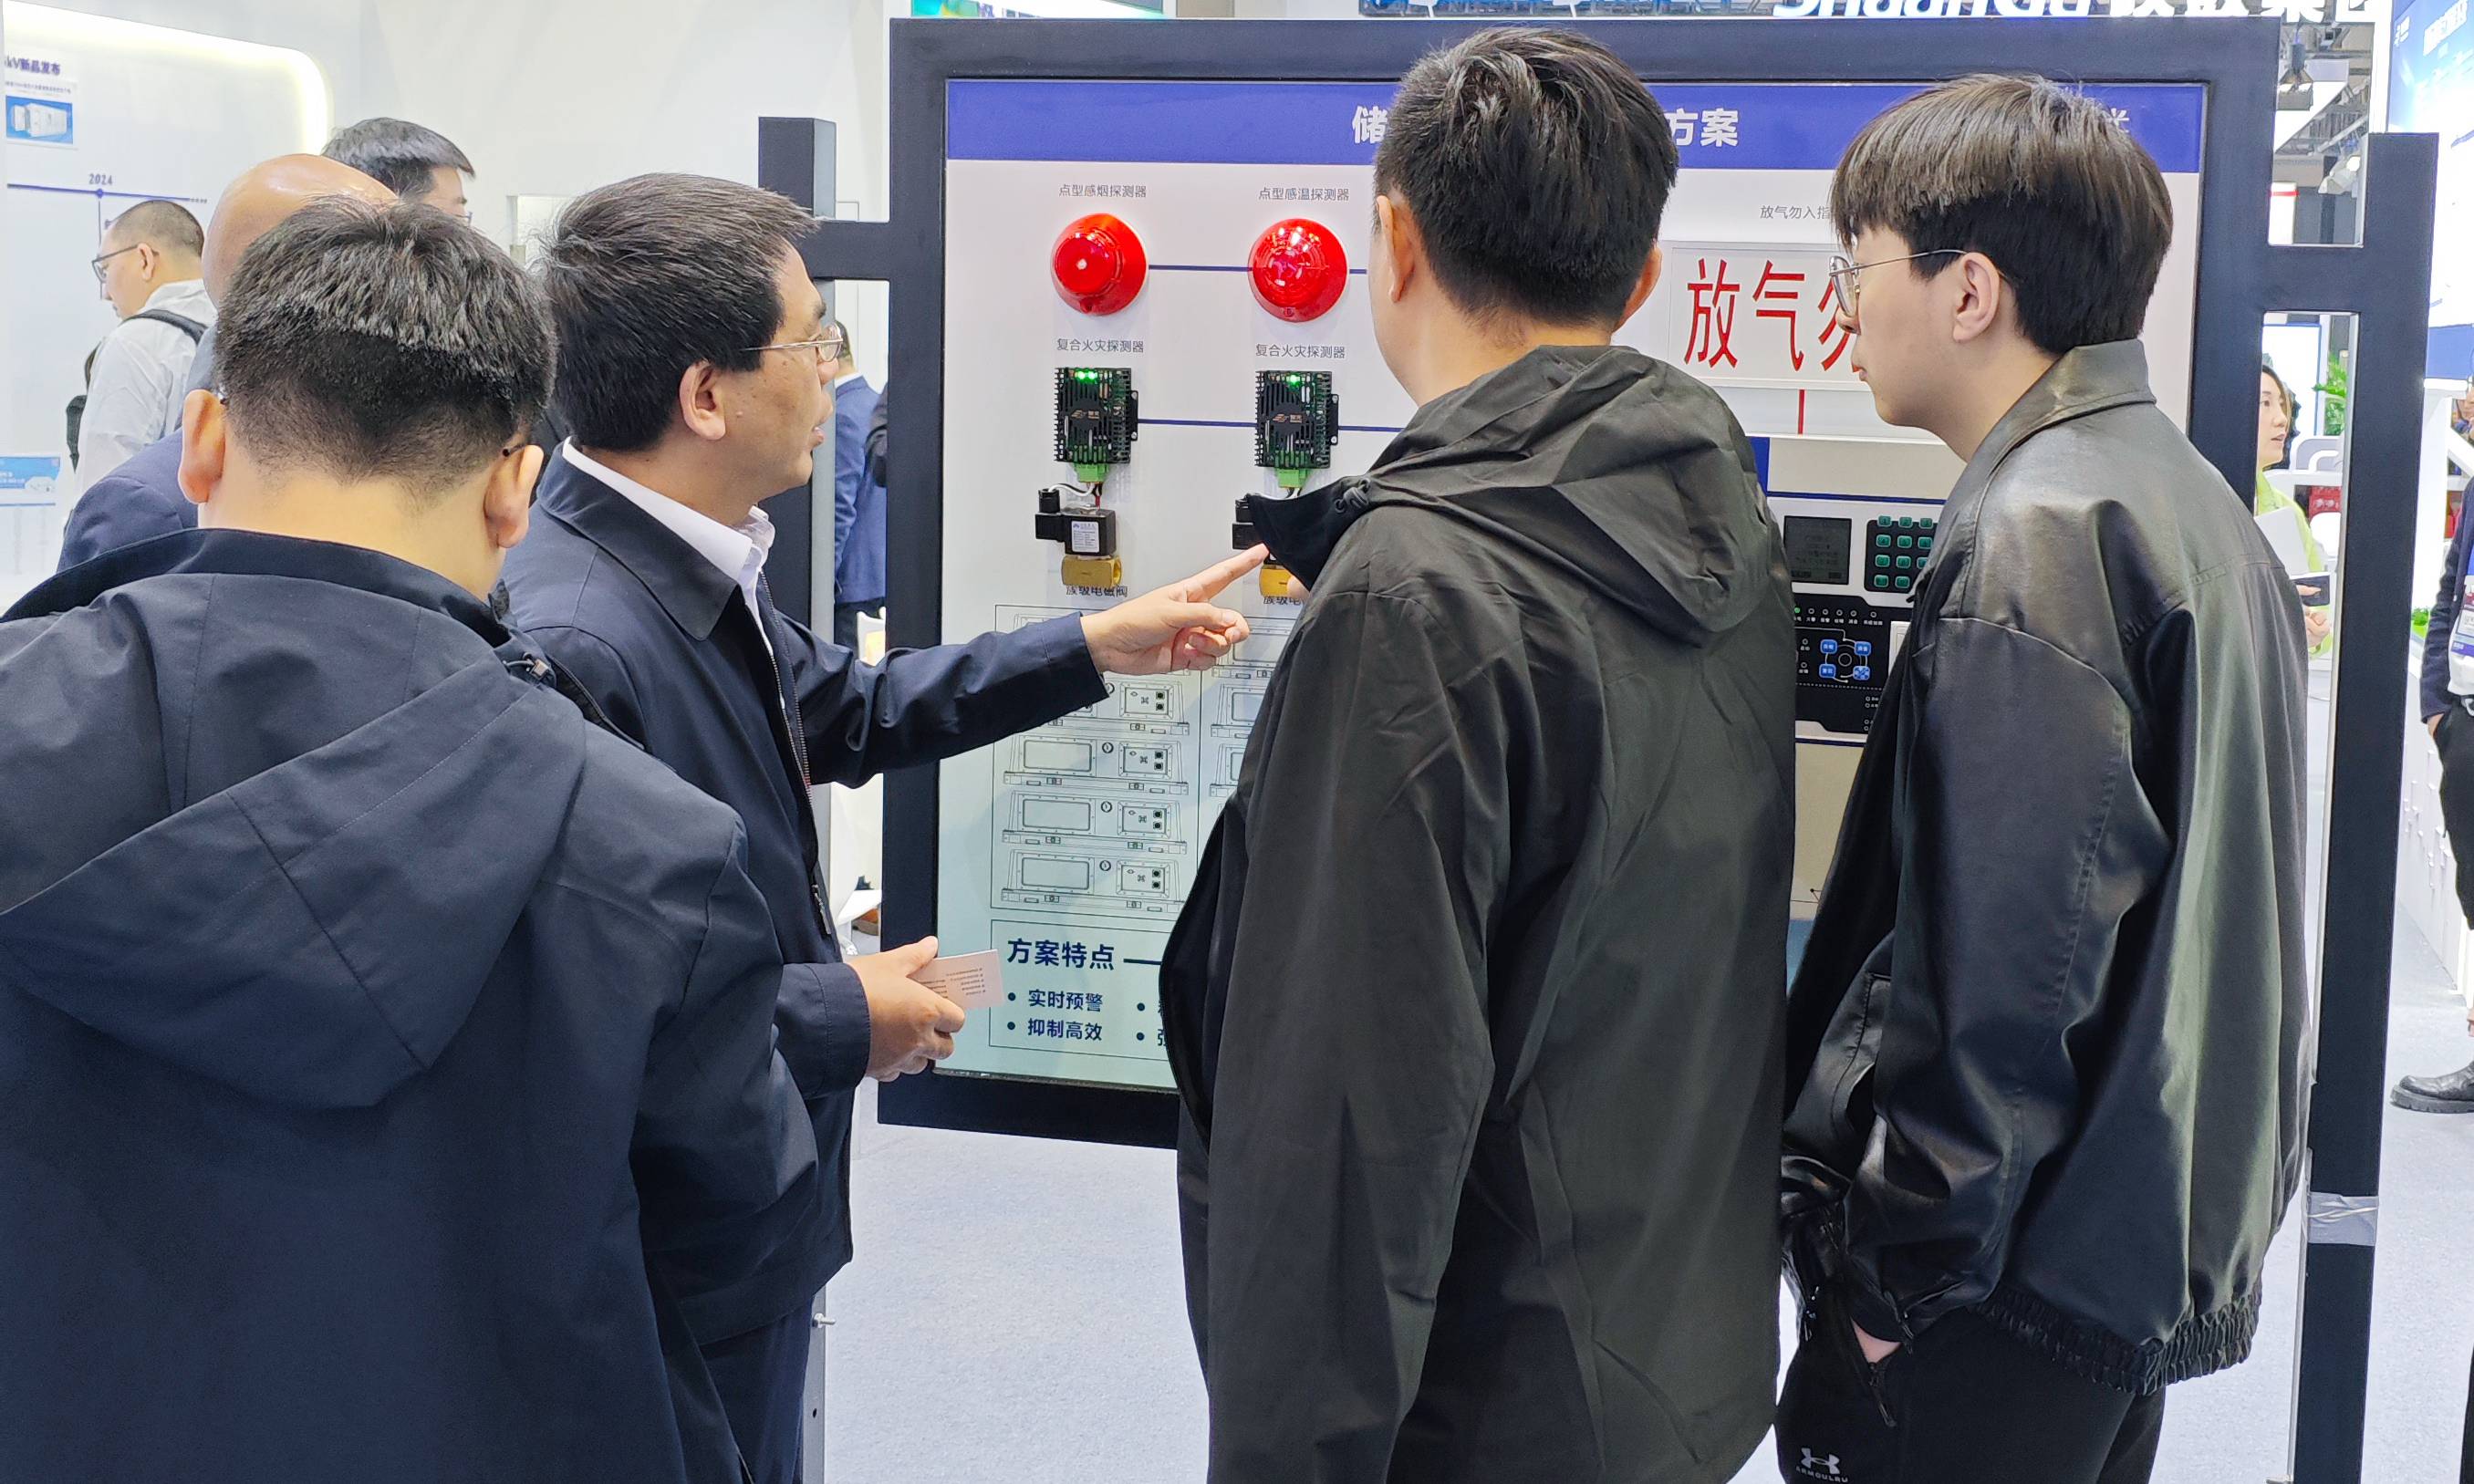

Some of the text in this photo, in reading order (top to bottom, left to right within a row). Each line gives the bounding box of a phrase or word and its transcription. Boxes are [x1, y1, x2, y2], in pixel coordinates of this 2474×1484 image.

[1352, 106, 1739, 147] 储 方案
[88, 172, 113, 185] 2024
[1059, 184, 1147, 198] 点型感烟探测器
[1258, 187, 1350, 202] 点型感温探测器
[1056, 338, 1145, 353] 复合火灾探测器
[1255, 344, 1346, 358] 复合火灾探测器
[1007, 938, 1115, 970] 方案特点
[1028, 989, 1104, 1012] 实时预警
[1027, 1018, 1103, 1042] 抑制高效
